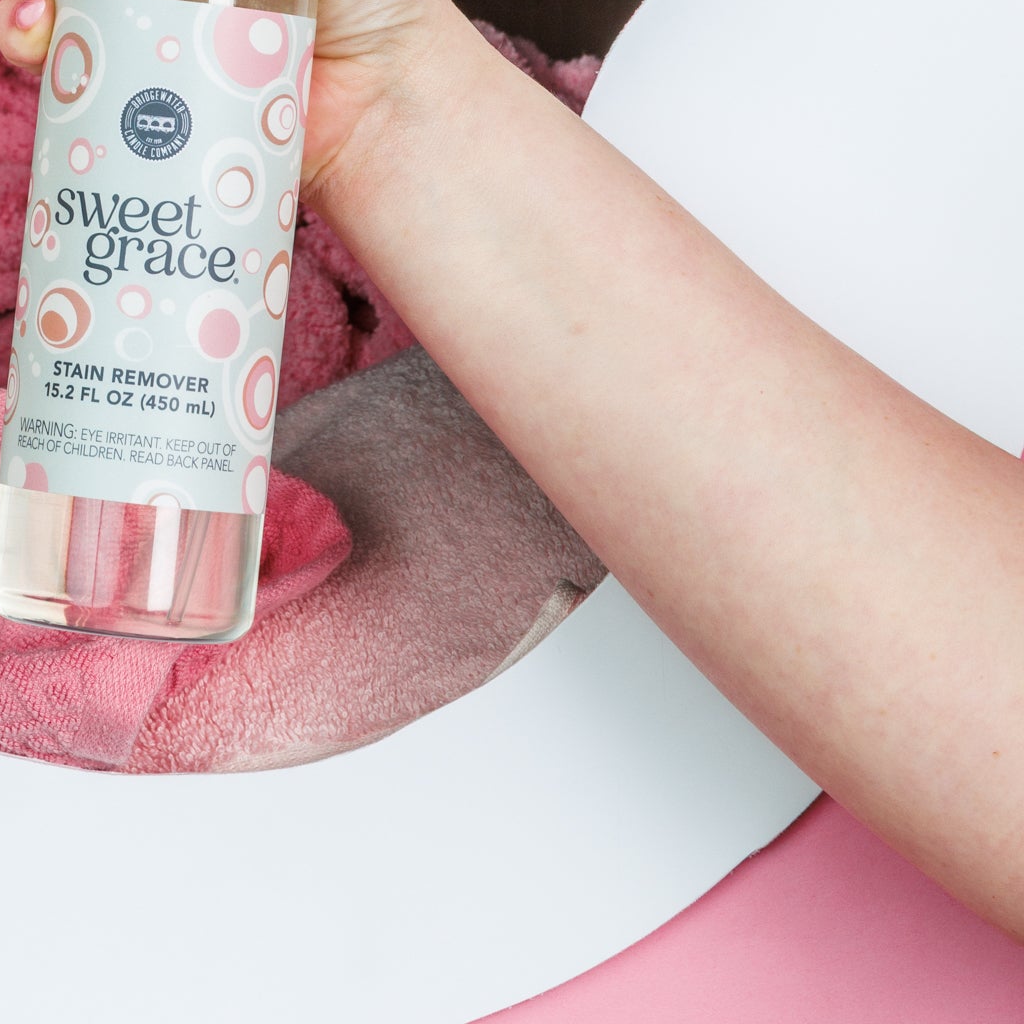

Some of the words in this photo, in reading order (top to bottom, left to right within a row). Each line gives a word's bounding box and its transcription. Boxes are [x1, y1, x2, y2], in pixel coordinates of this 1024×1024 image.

[131, 90, 186, 114] BRIDGEWATER
[124, 129, 149, 156] CANDLE
[150, 134, 186, 158] COMPANY
[55, 188, 202, 240] sweet
[53, 360, 105, 382] STAIN
[111, 367, 210, 394] REMOVER
[44, 381, 75, 400] 15.2
[80, 386, 100, 403] FL
[106, 389, 134, 407] OZ
[140, 393, 180, 412] (450
[185, 400, 216, 418] mL)
[17, 434, 45, 451] REACH
[46, 439, 62, 453] OF
[63, 441, 126, 462] CHILDREN.
[129, 449, 164, 466] READ
[166, 454, 199, 470] BACK
[20, 417, 78, 440] WARNING:
[81, 428, 103, 443] EYE
[105, 431, 162, 450] IRRITANT.
[165, 437, 196, 453] KEEP
[197, 441, 222, 455] OUT
[222, 443, 237, 457] OF
